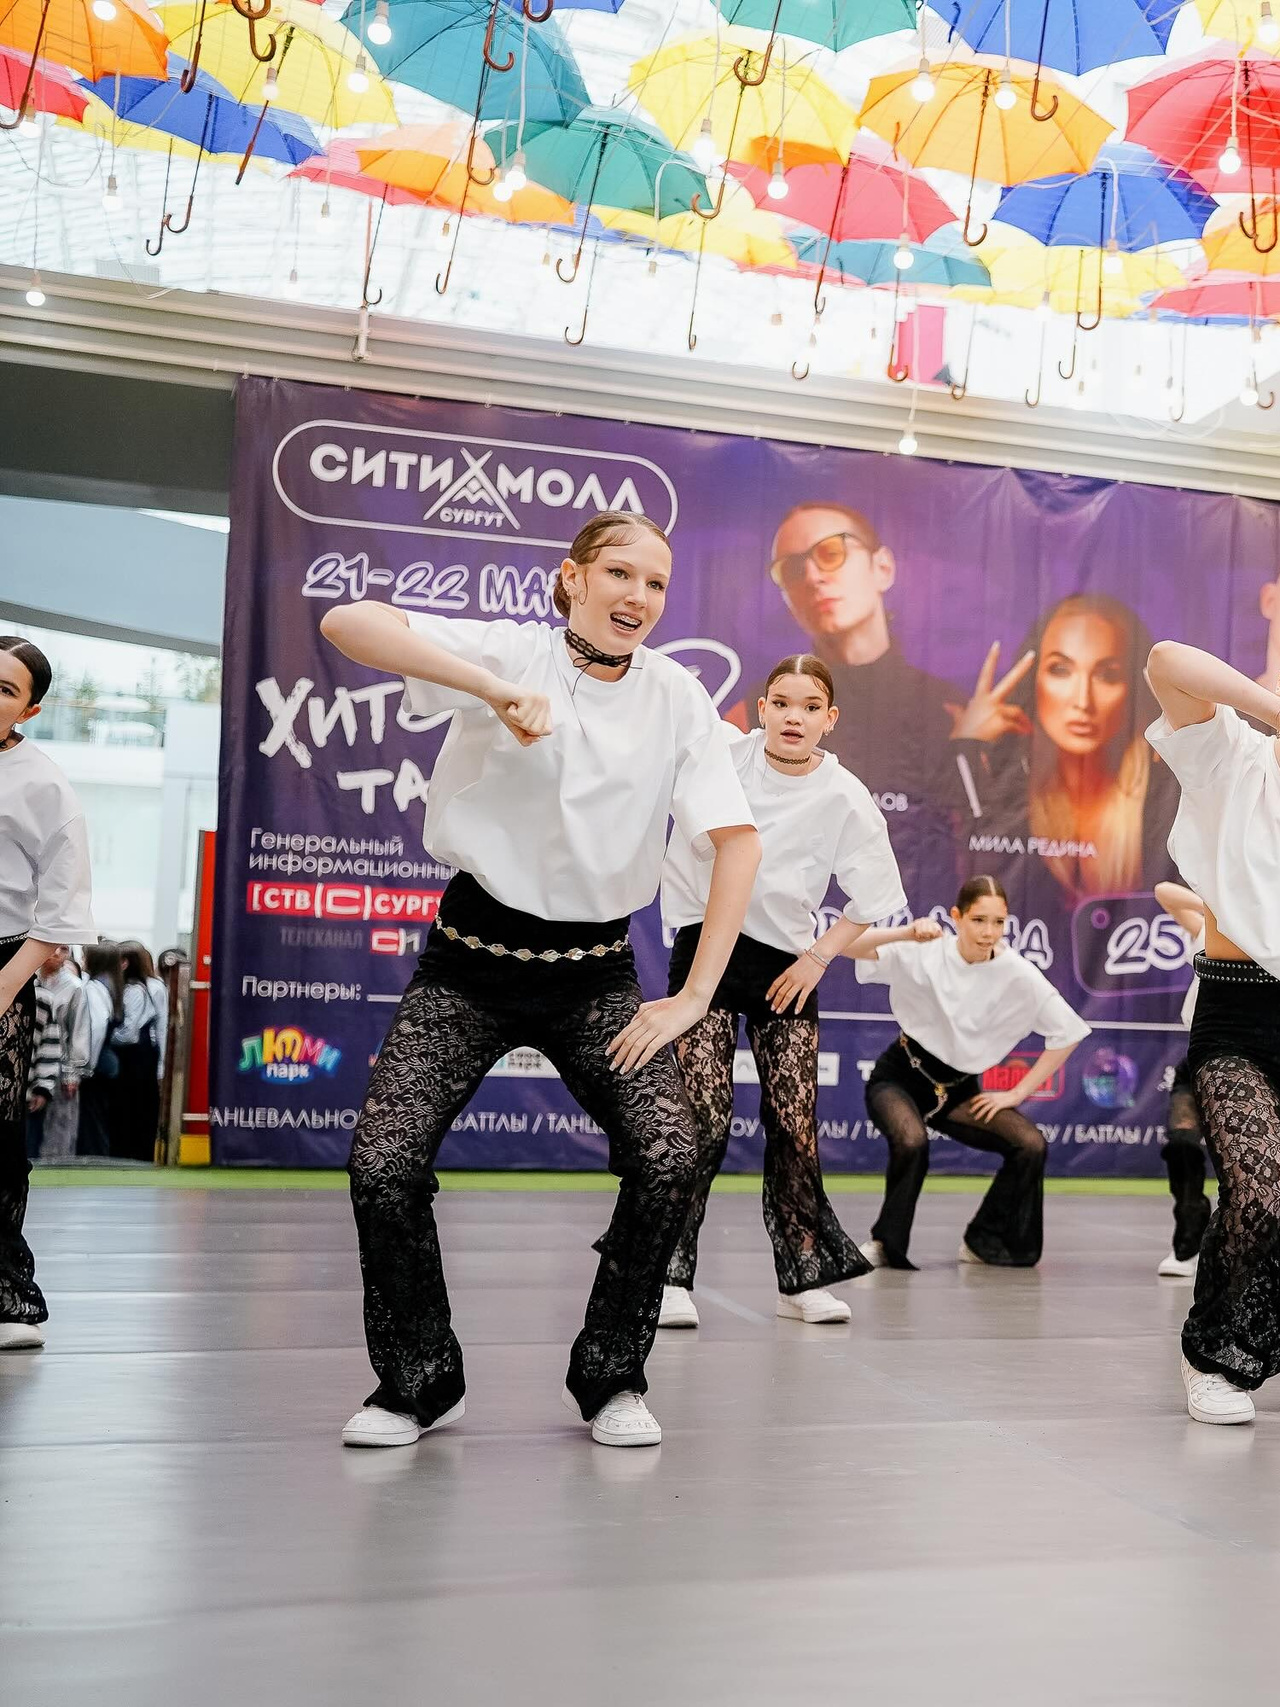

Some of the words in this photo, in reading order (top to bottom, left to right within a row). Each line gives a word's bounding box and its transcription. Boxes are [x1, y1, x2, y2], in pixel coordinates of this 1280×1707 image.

[309, 443, 454, 492] СИТИ
[497, 463, 645, 515] МОЛЛ
[439, 506, 505, 528] СУРГУТ
[302, 551, 471, 610] 21-22
[336, 758, 431, 814] ТА
[250, 827, 404, 857] Генеральный
[969, 834, 1025, 855] МИЛА
[1027, 836, 1099, 859] РЕДИНА
[249, 852, 459, 881] информационны
[281, 926, 363, 948] ТЕЛЕКАНАЛ
[1104, 915, 1188, 975] 25
[242, 975, 362, 1001] Партнеры:
[266, 1063, 309, 1082] парк
[209, 1106, 361, 1131] АНЦЕВАЛЬНО
[547, 1111, 606, 1135] ТАНЦ
